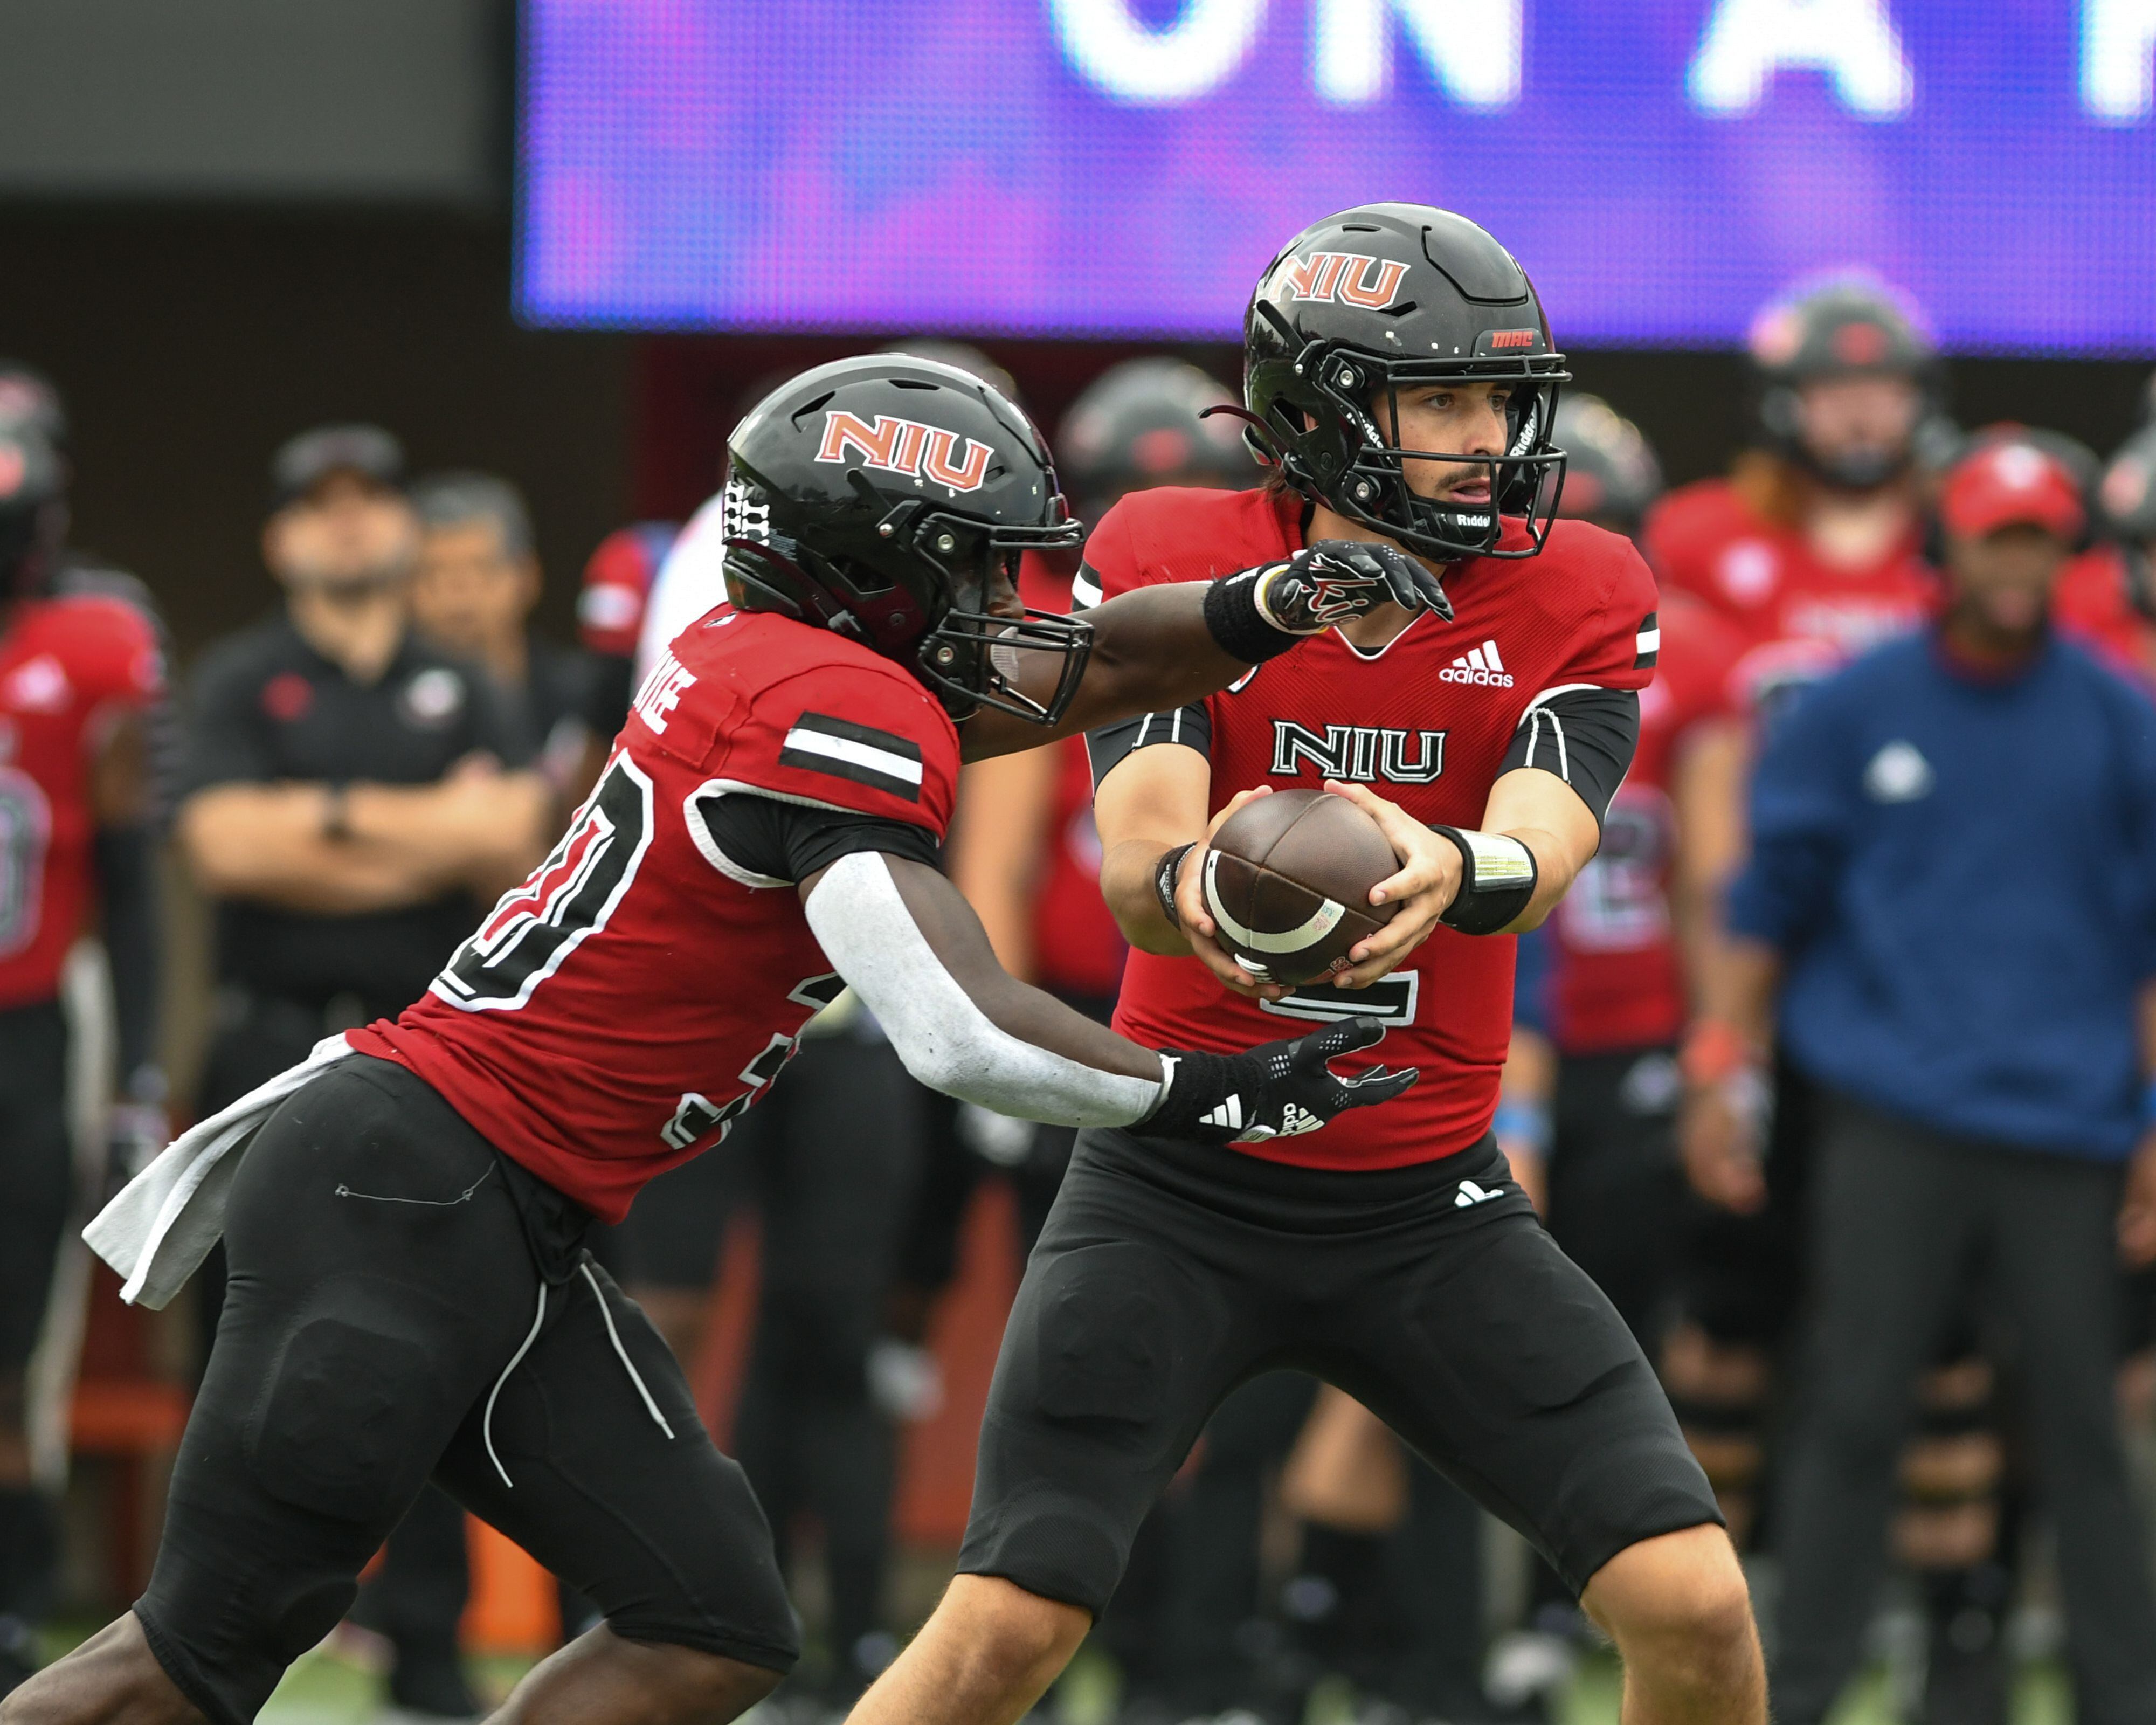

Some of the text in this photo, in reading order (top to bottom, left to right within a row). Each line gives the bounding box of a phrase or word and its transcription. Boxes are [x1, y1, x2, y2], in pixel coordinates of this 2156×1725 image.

[1267, 251, 1410, 310] NIU
[1492, 331, 1533, 347] MAC
[814, 410, 994, 492] NIU
[1439, 666, 1514, 688] adidas
[1268, 719, 1448, 784] NIU
